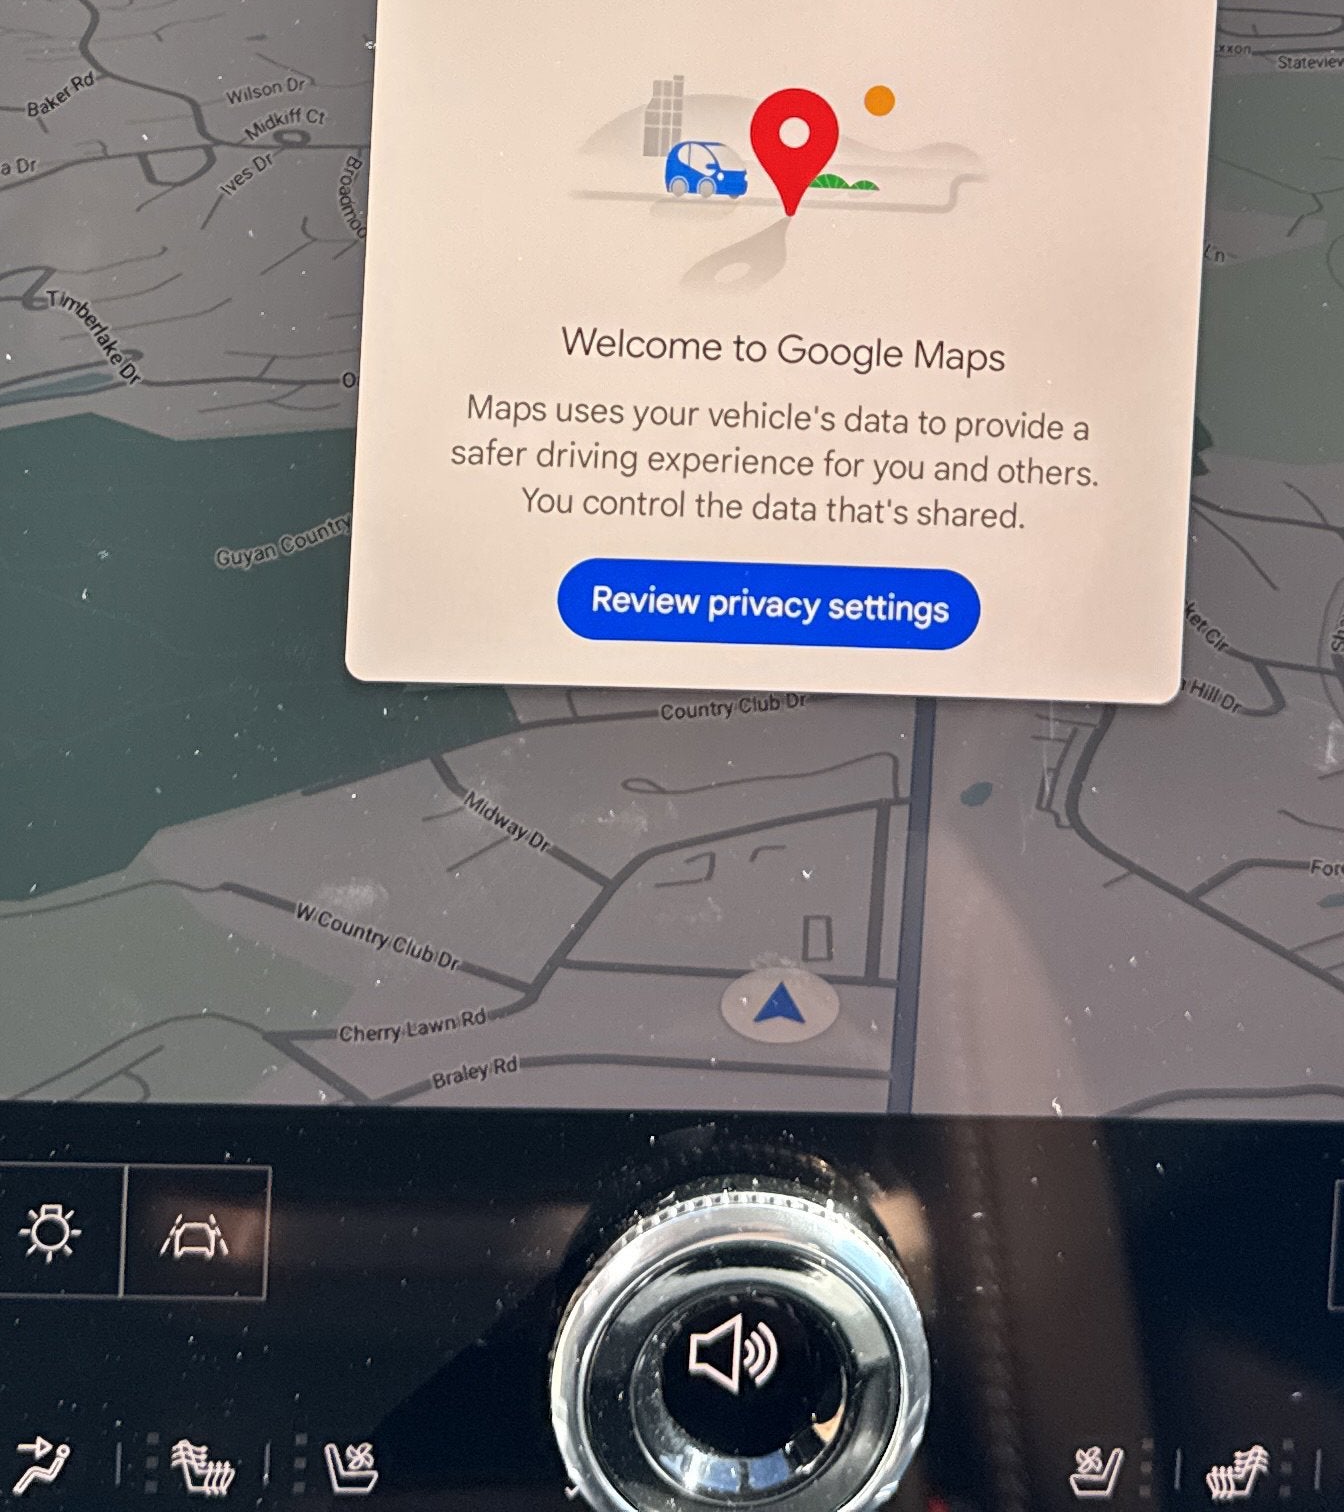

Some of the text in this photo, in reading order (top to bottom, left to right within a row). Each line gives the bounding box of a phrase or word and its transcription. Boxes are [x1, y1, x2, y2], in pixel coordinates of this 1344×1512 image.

[27, 73, 95, 117] Baker Rd
[226, 77, 306, 106] Wilson Dr
[246, 109, 303, 140] Midkiff
[16, 157, 37, 175] Dr
[221, 153, 274, 195] Ives Dr
[47, 290, 141, 386] Timberlake Dr
[561, 326, 1006, 374] Welcome to Google Maps
[468, 394, 1089, 443] Maps uses your vehicle's data to provide a
[451, 440, 1098, 487] safer driving experience for you and others.
[521, 487, 1024, 531] You control the data that's shared.
[215, 515, 352, 568] Guyan Country
[591, 584, 949, 626] Review privacy settings
[660, 693, 807, 722] Country Club Dr
[1190, 680, 1219, 703] Hill
[1220, 695, 1242, 713] Dr
[464, 792, 552, 854] Midway Dr
[295, 903, 461, 970] W Country Club Dr
[340, 1009, 487, 1047] Cherry Lawn Rd
[432, 1056, 518, 1092] Braley Rd
